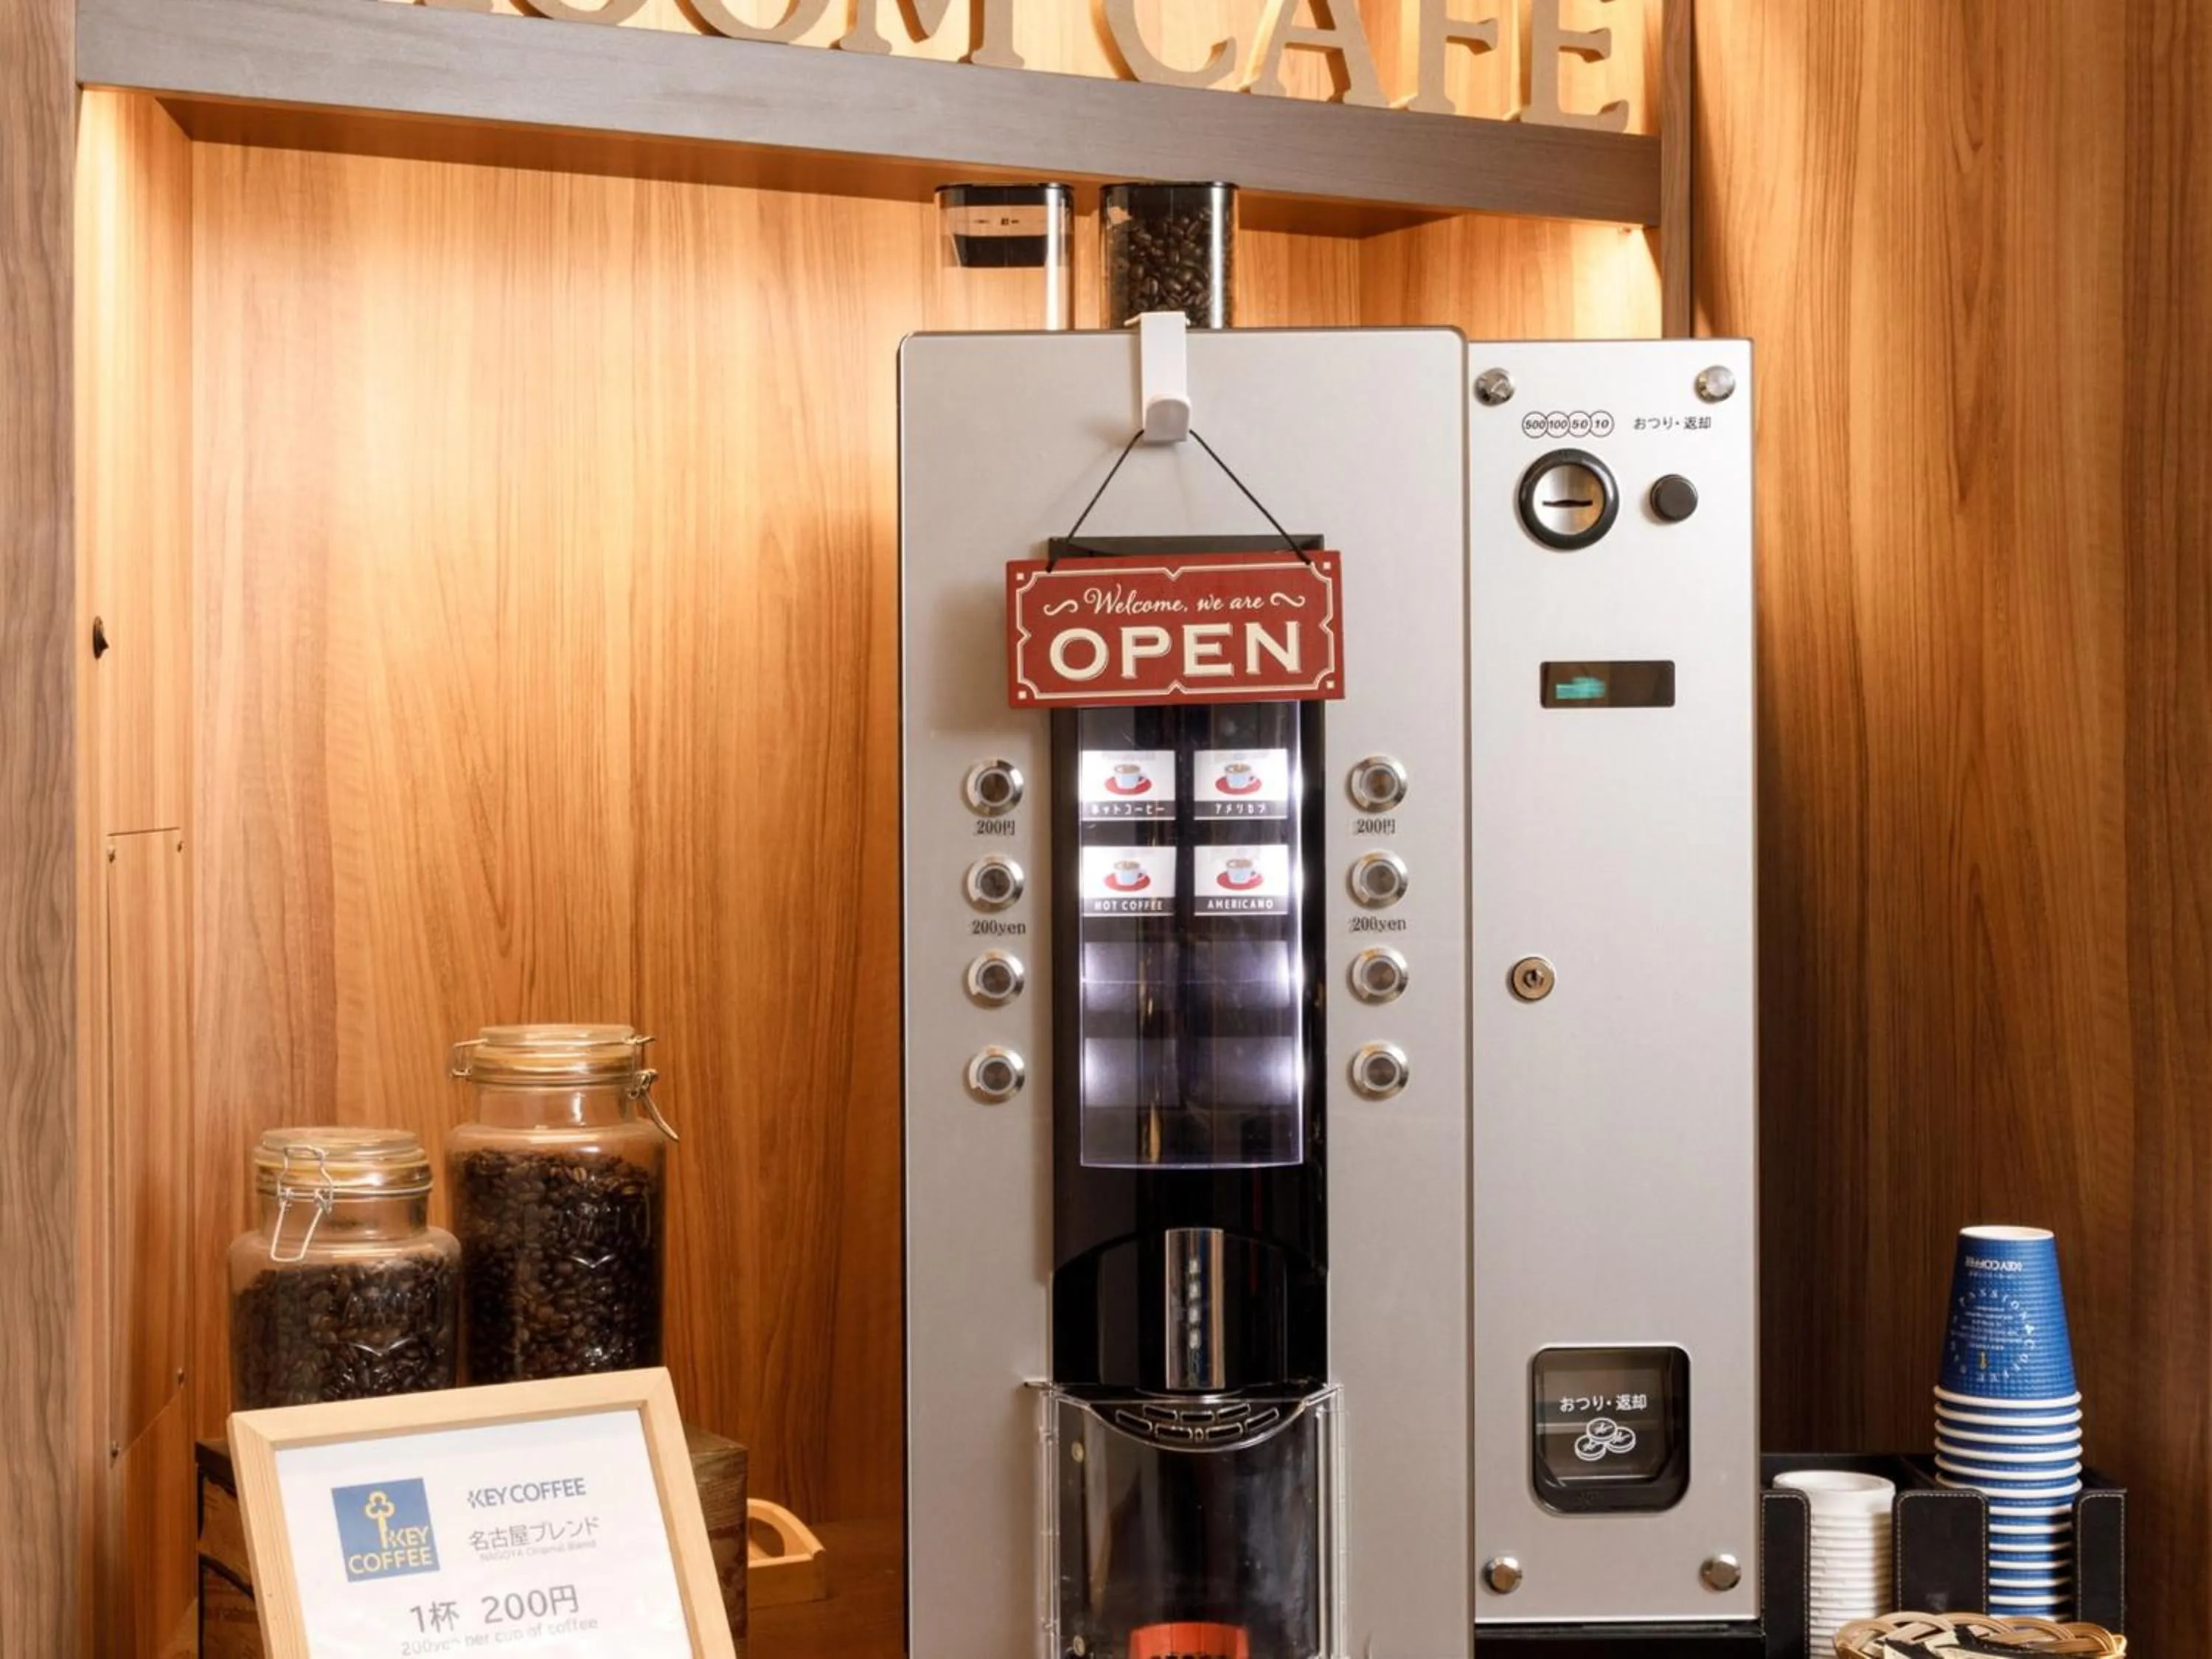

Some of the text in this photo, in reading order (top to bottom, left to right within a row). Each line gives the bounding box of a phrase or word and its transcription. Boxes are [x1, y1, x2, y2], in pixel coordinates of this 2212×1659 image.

[1526, 419, 1610, 430] 500 100 50 10
[1633, 416, 1711, 430] おつり・返却
[1197, 594, 1224, 611] we
[1229, 597, 1264, 611] are
[1049, 621, 1301, 681] OPEN
[976, 820, 1015, 836] 200円
[1094, 900, 1164, 911] HOT COFFEE
[1207, 899, 1274, 910] AMERICANO
[972, 919, 1027, 937] 200yen
[1352, 917, 1407, 933] 200yen
[1559, 1394, 1647, 1412] おつり・返却
[389, 1526, 428, 1548] KEY
[469, 1517, 599, 1551] 名古屋ブレンド
[349, 1547, 433, 1574] COFFEE
[410, 1585, 580, 1634] 1杯 200円
